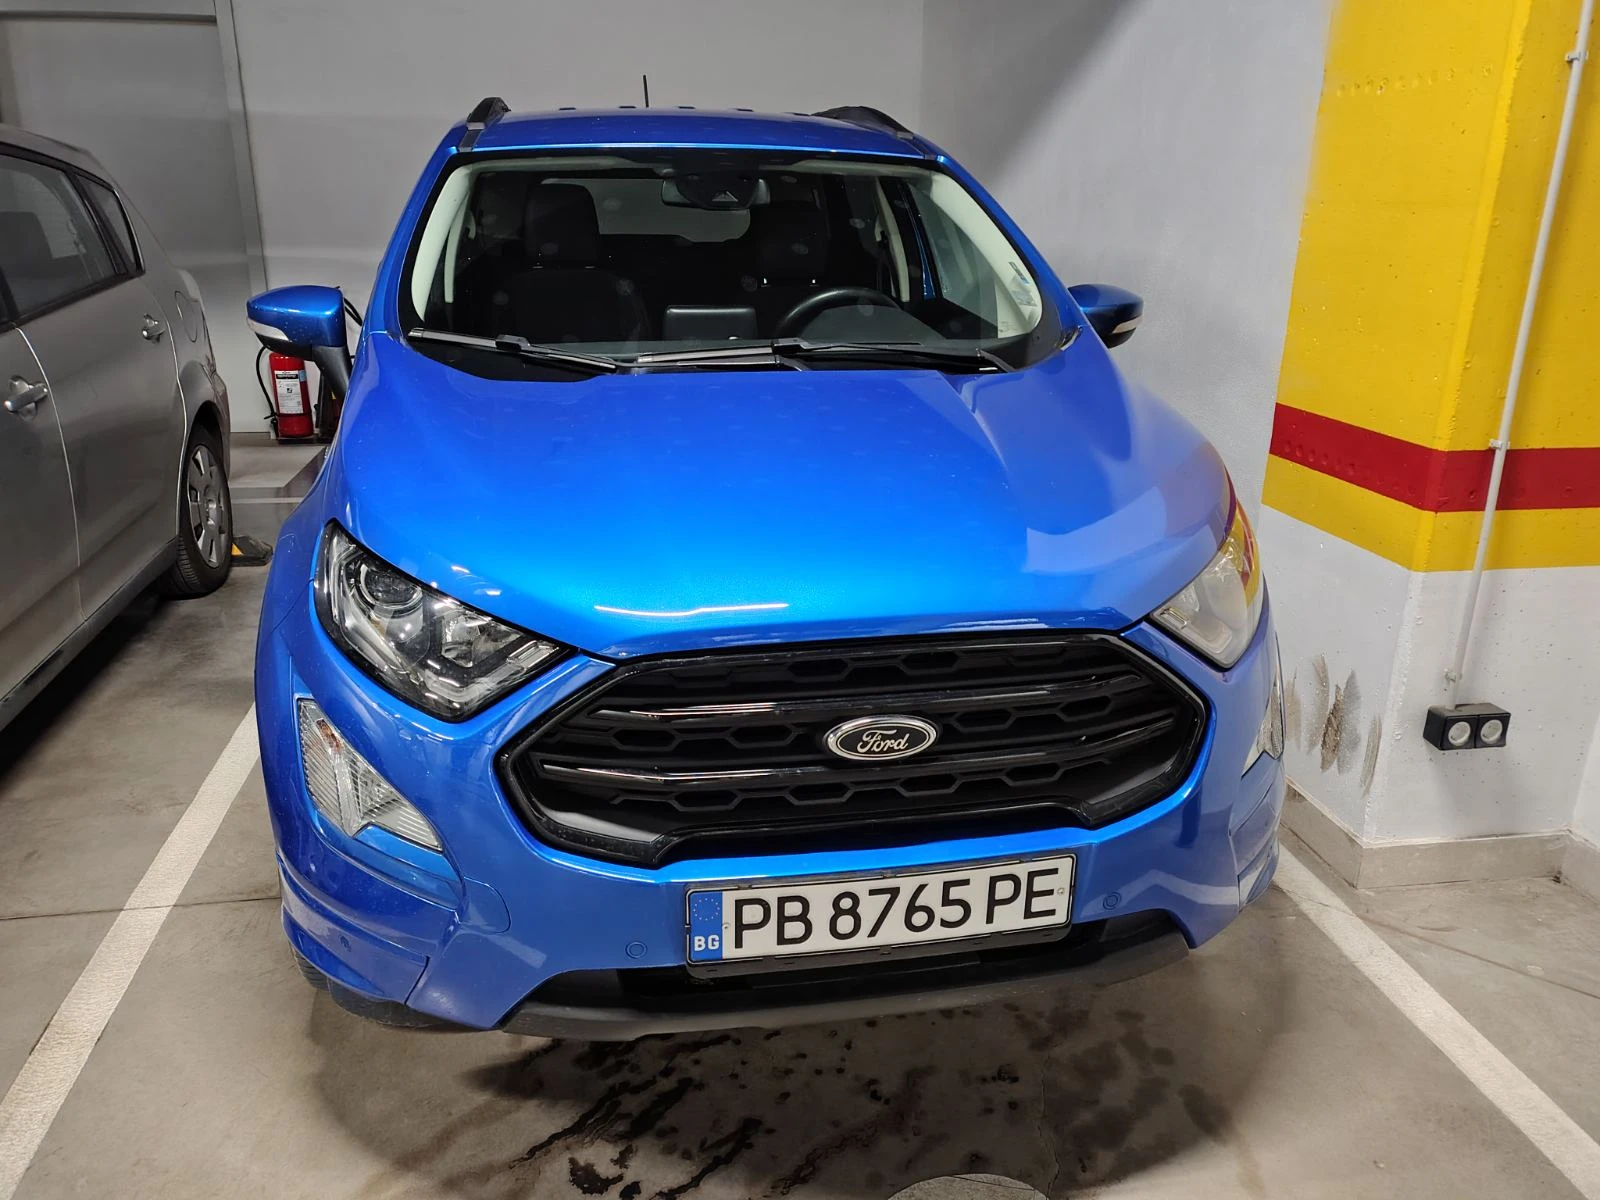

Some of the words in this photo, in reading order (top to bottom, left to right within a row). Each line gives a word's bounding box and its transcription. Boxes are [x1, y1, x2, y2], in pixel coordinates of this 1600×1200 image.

[857, 729, 910, 753] Ford
[734, 895, 813, 949] PB
[829, 878, 972, 940] 8765
[985, 867, 1059, 925] PE
[694, 935, 720, 951] BG
